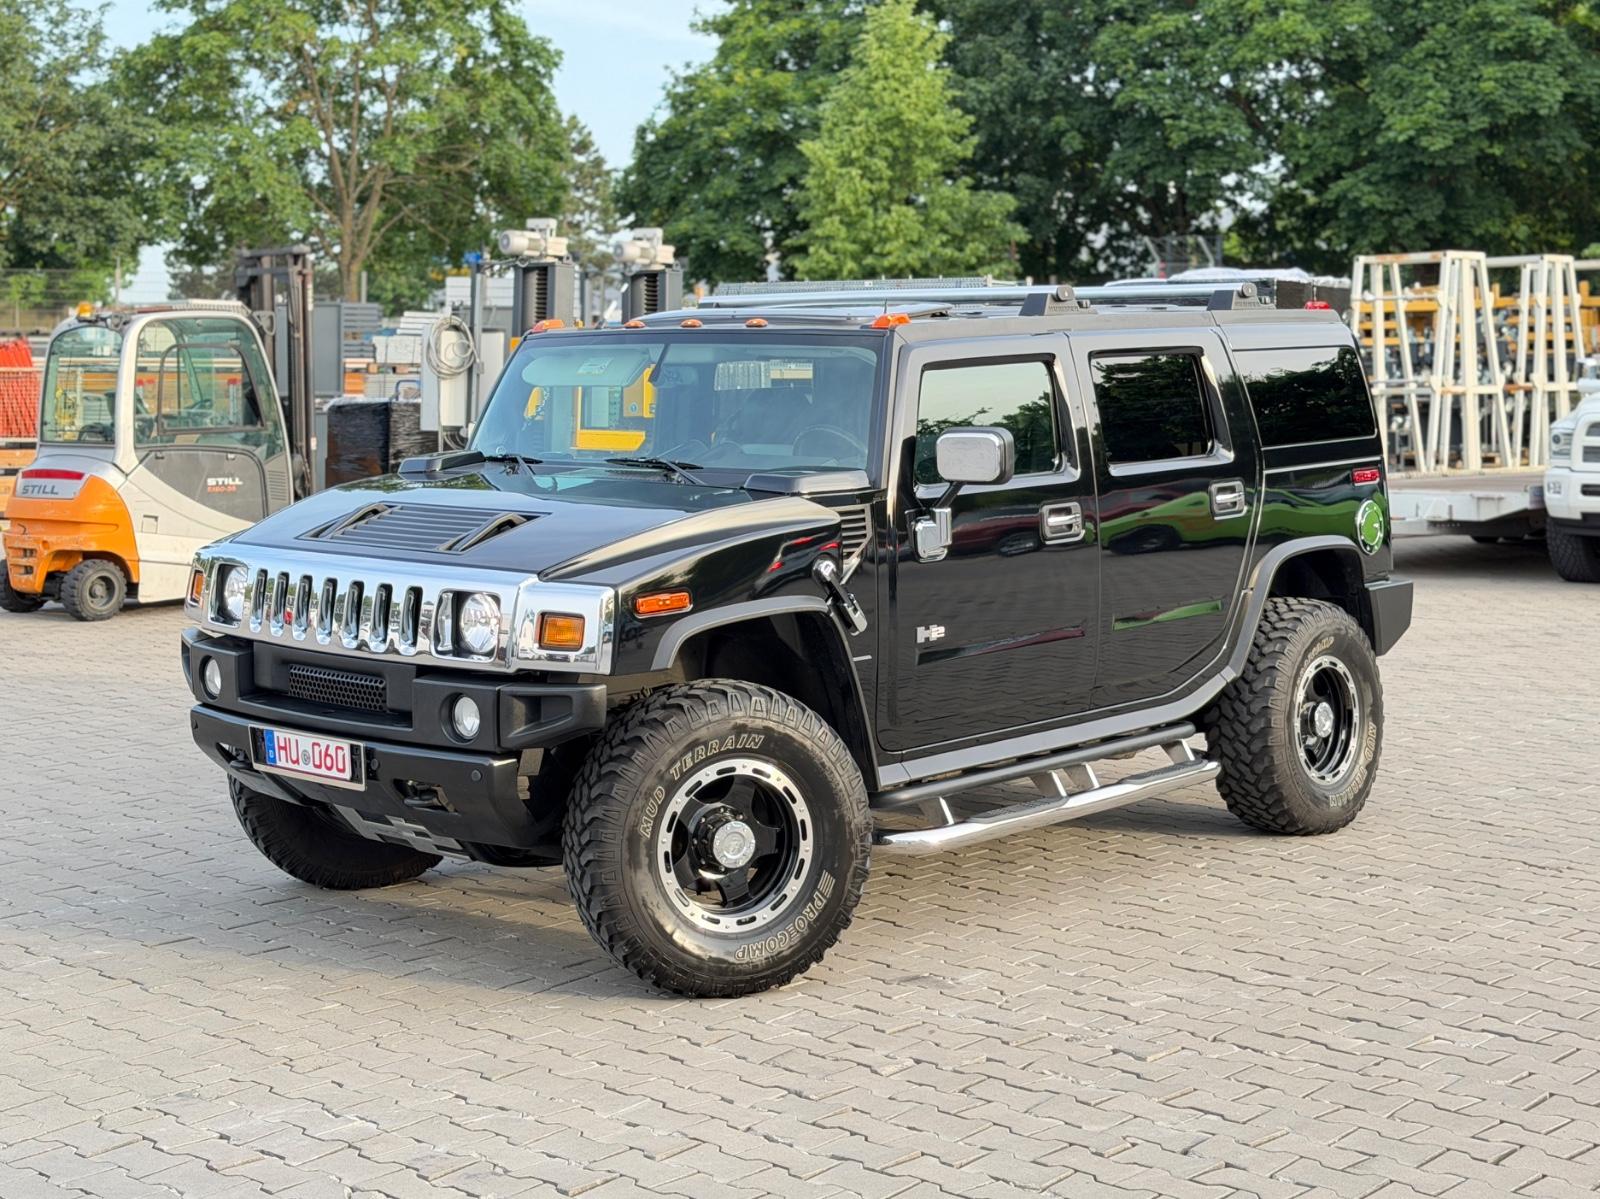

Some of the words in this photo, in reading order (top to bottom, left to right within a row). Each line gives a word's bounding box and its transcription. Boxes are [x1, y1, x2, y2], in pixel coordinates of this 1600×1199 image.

[21, 484, 59, 496] STILL
[207, 477, 244, 486] STILL
[916, 624, 946, 644] H2
[276, 735, 300, 766] HU
[311, 742, 346, 773] 060
[639, 785, 666, 839] MUD
[669, 733, 765, 781] TERRAIN
